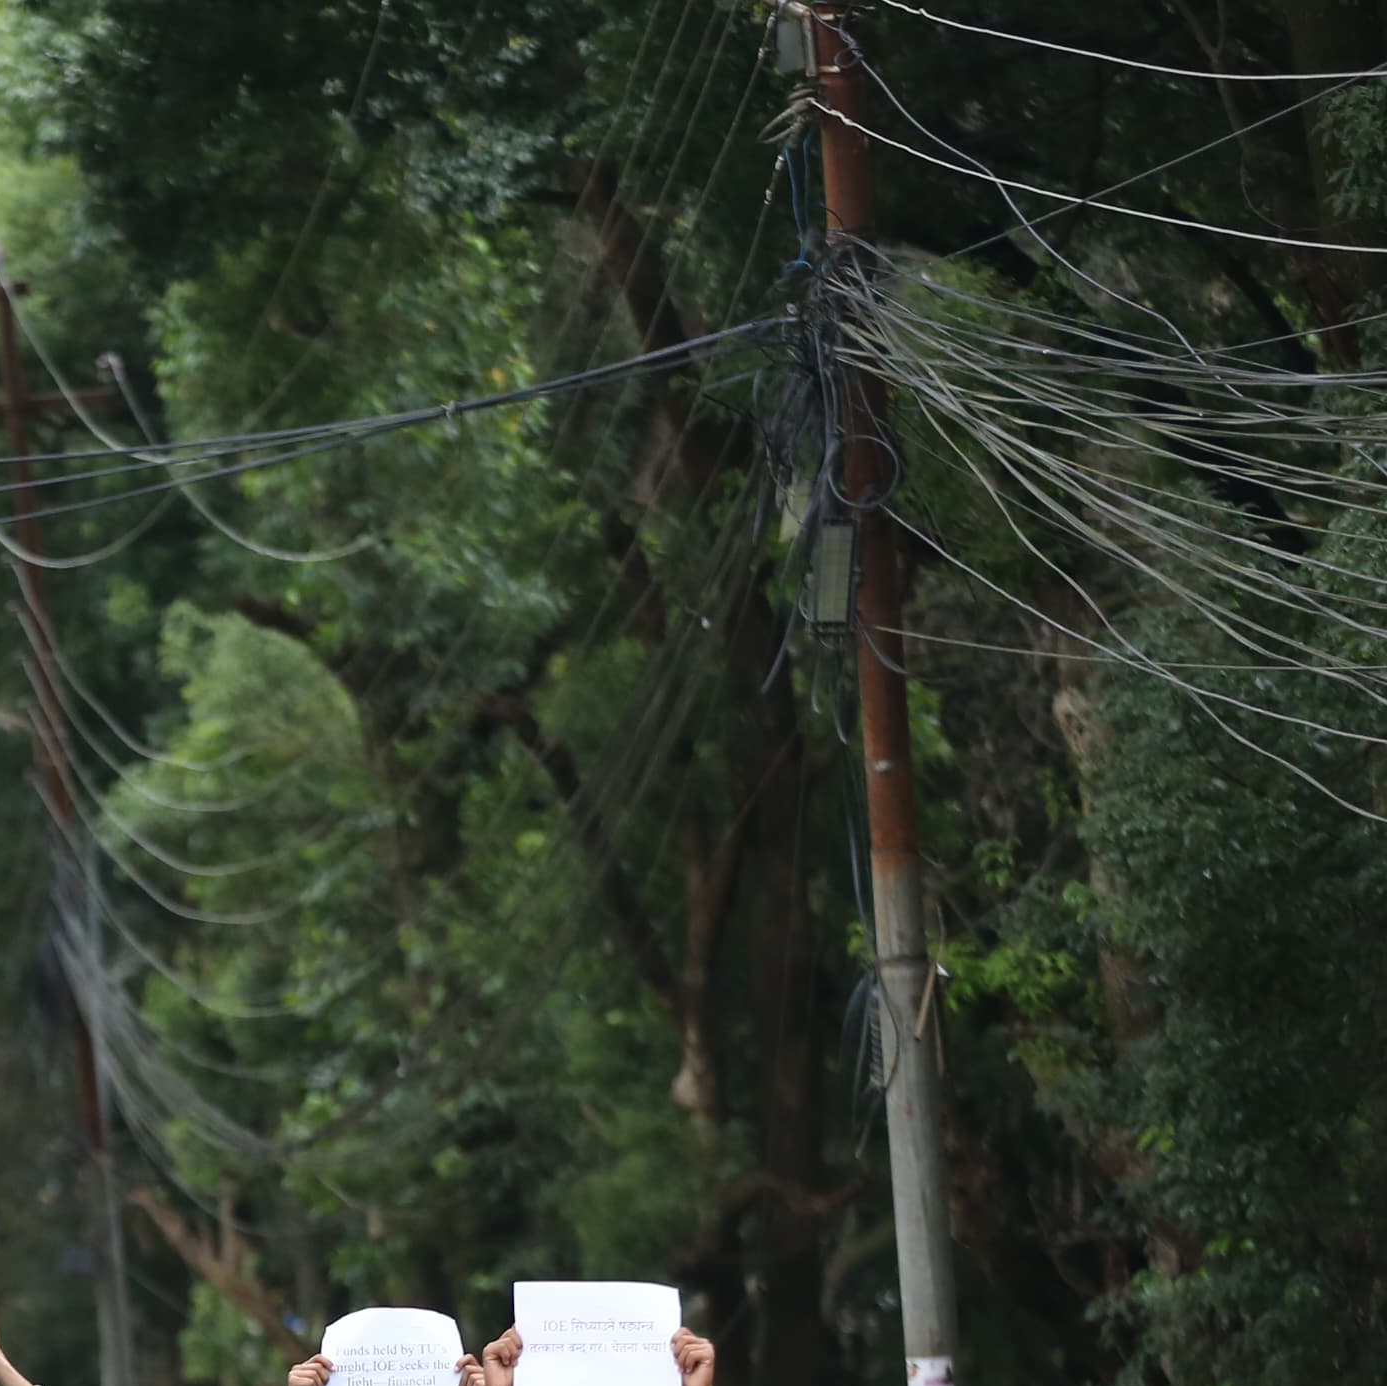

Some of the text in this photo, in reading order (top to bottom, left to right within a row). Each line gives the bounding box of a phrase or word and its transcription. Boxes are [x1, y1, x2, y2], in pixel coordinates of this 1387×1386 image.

[543, 1319, 568, 1332] IOE
[335, 1344, 370, 1357] Funds
[372, 1344, 397, 1356] held
[400, 1343, 414, 1357] by
[528, 1343, 565, 1353] तत्काल
[372, 1360, 396, 1371] IOE
[399, 1360, 429, 1371] seeks
[432, 1359, 450, 1370] the
